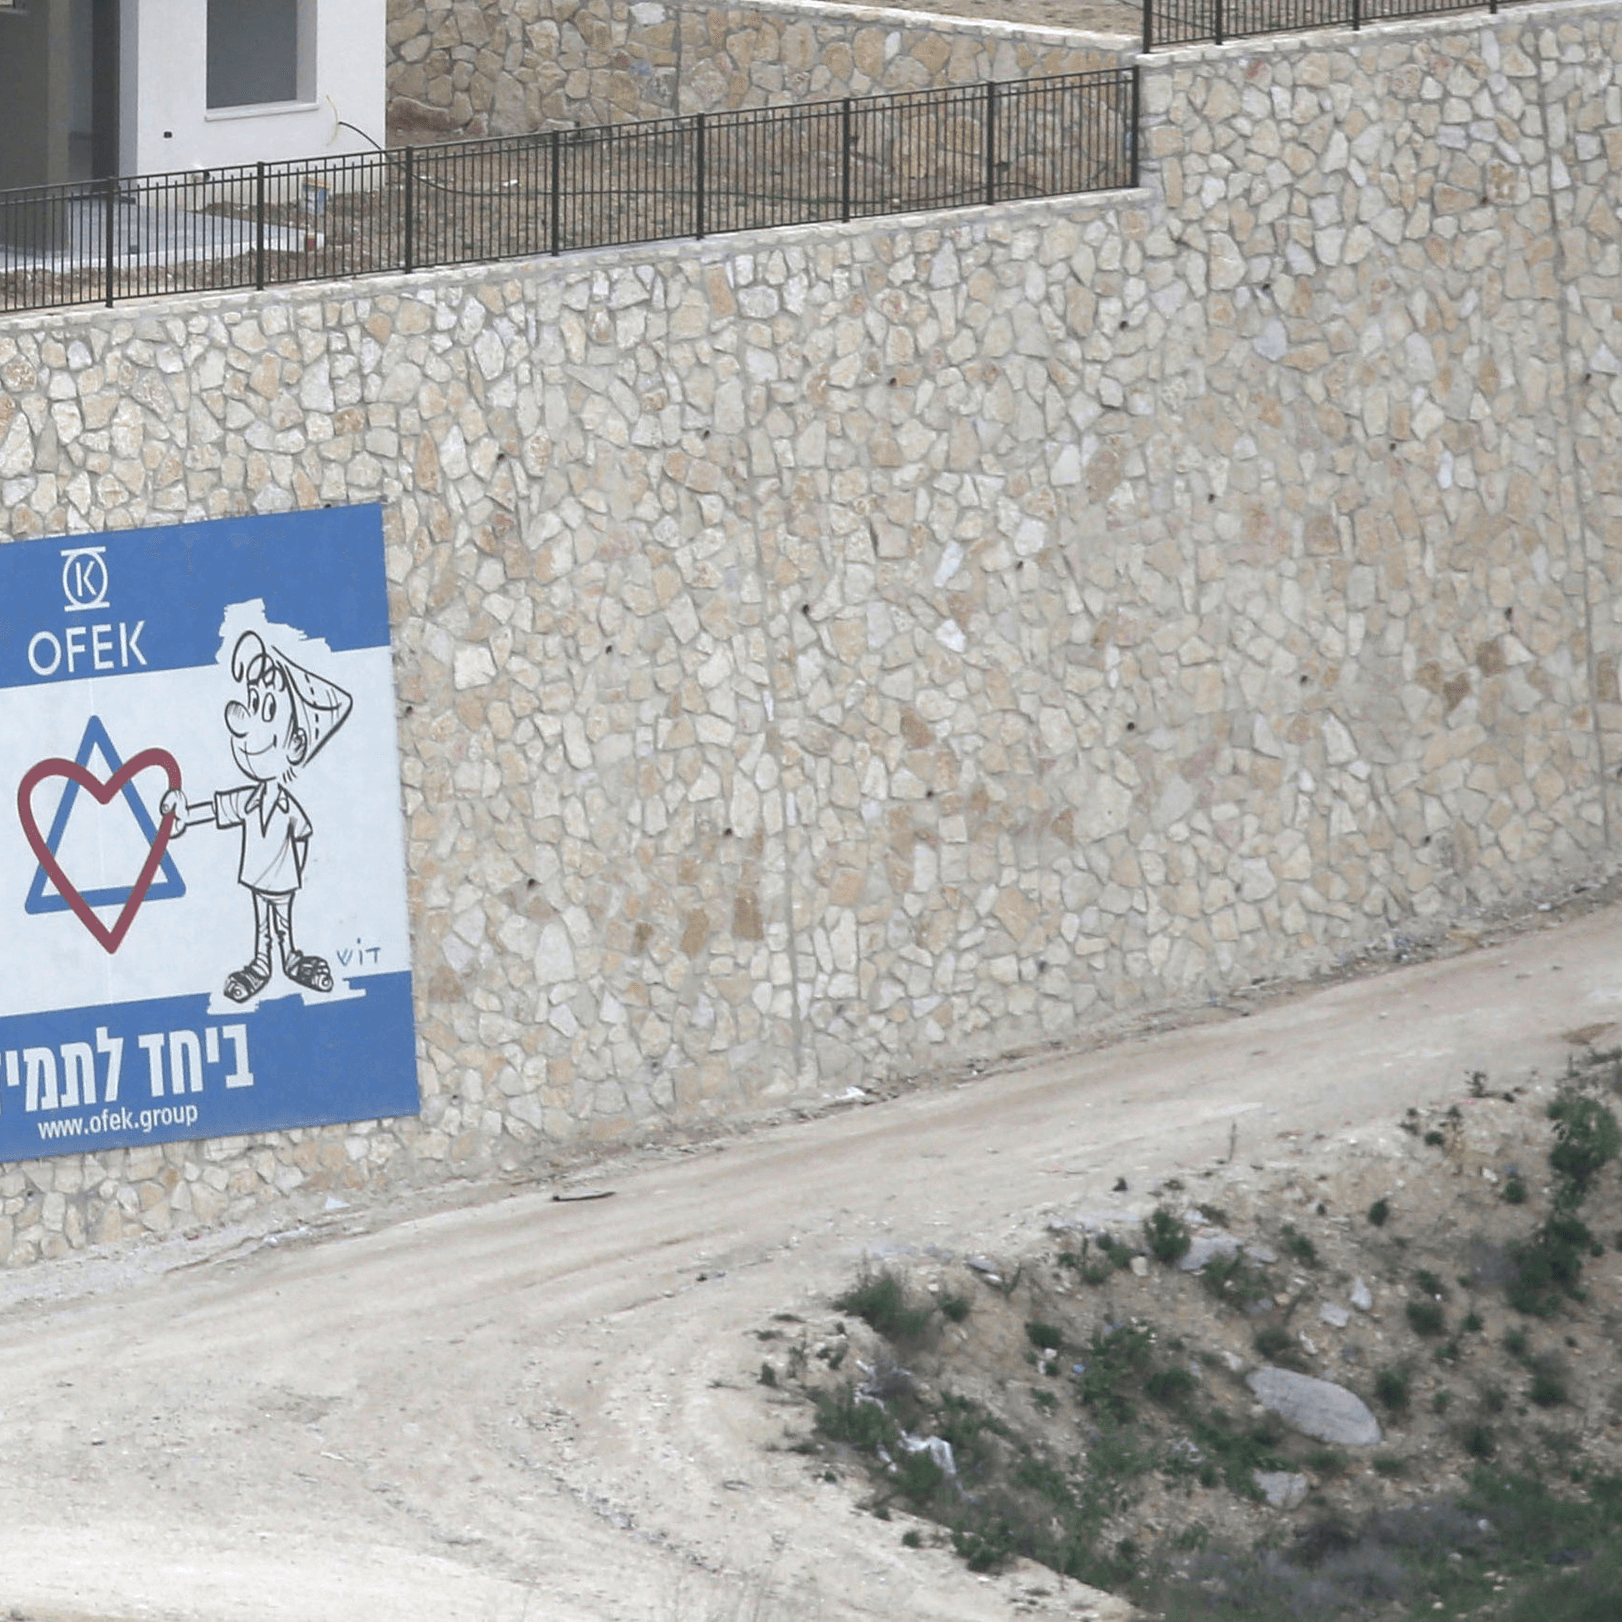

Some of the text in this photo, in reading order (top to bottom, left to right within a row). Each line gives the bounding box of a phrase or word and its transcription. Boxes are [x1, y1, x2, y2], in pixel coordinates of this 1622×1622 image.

[27, 620, 148, 676] OFEK
[137, 1023, 254, 1098] ביחד
[37, 1104, 199, 1140] www.ofek.group
